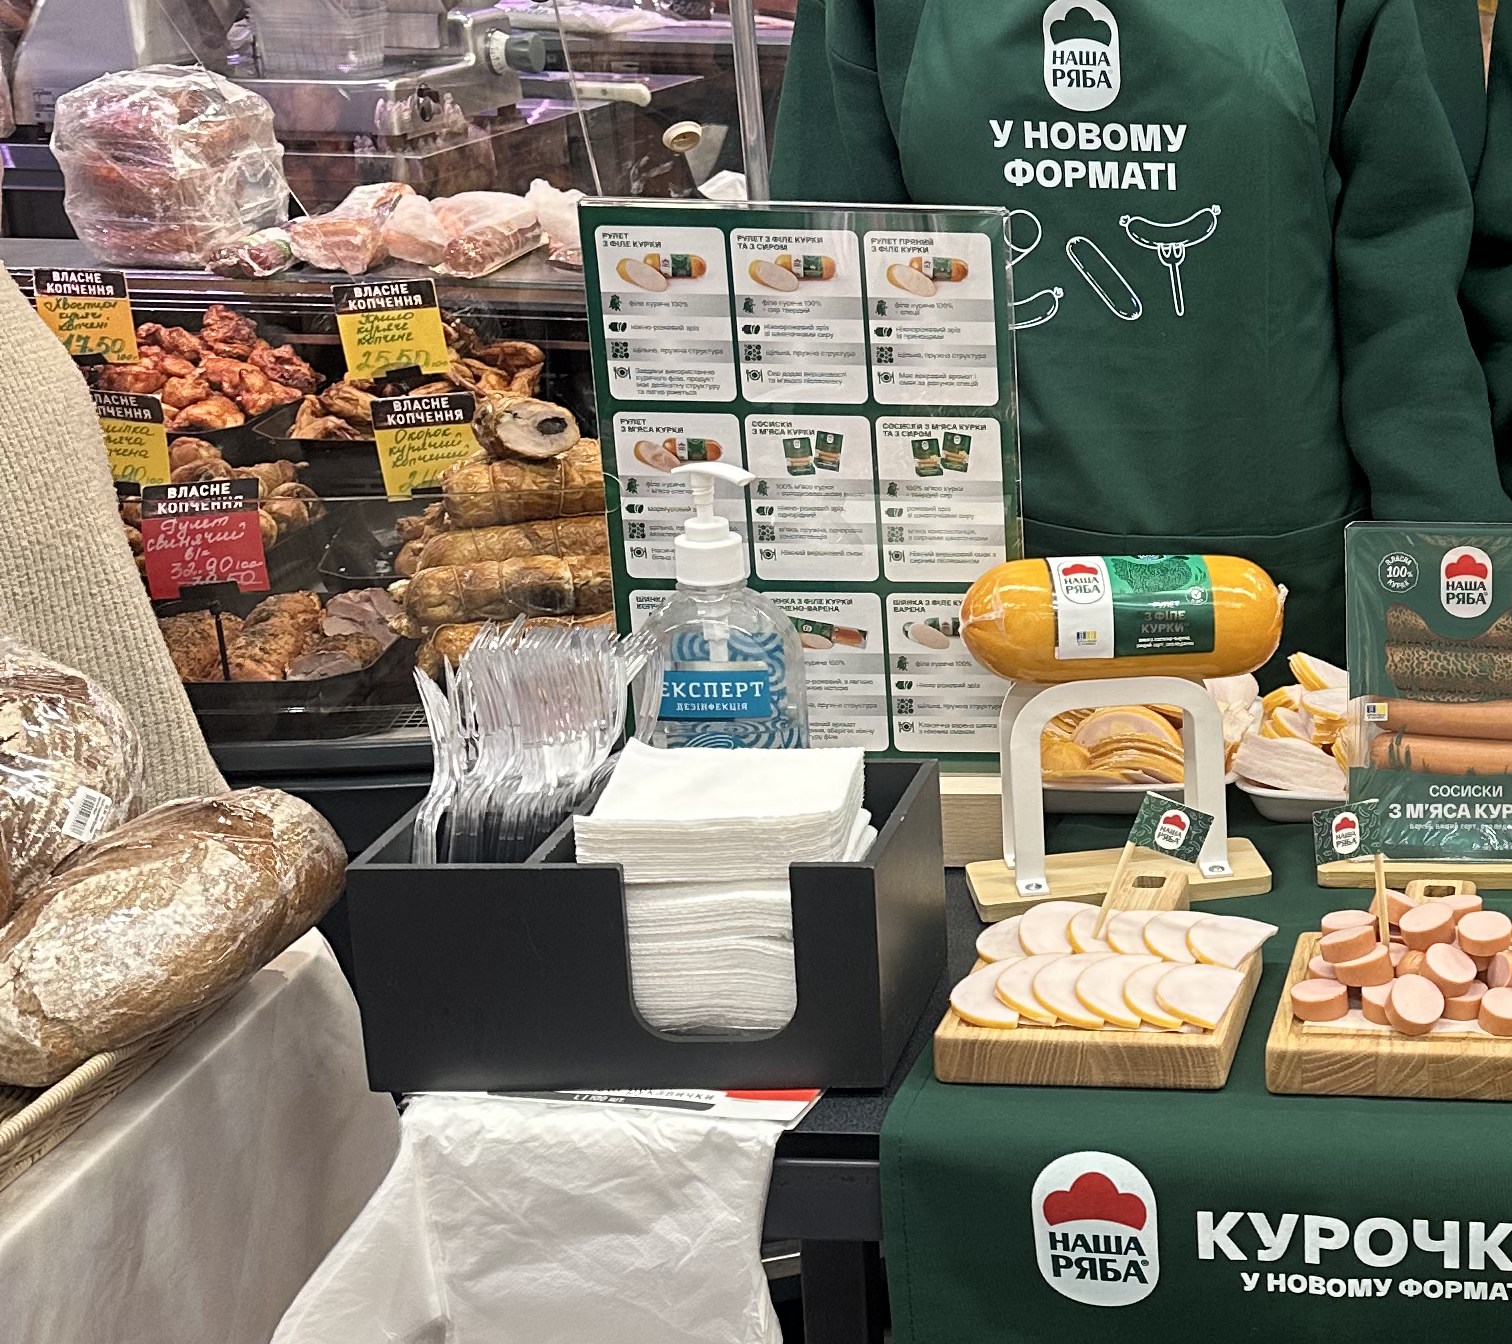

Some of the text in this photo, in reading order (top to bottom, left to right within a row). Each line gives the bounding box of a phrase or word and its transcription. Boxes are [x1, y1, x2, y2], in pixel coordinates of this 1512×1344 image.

[1052, 50, 1111, 67] НАША
[1052, 69, 1112, 88] РЯБА
[989, 119, 1187, 152] У НОВОМУ
[1004, 158, 1177, 190] ФОРМАТІ
[52, 272, 102, 283] ВЛАСНЕ
[47, 283, 114, 295] КОПЧЕННЯ
[353, 284, 408, 297] ВЛАСНЕ
[348, 295, 422, 310] КОПЧЕННЯ
[94, 394, 138, 407] ЛАСНЕ
[393, 397, 450, 411] ВЛАСНЕ
[97, 406, 152, 419] ПЧЕННЯ
[387, 409, 463, 425] КОПЧЕННЯ
[168, 483, 231, 499] ВЛАСНЕ
[1387, 566, 1413, 578] 100%
[1064, 576, 1099, 585] НАША
[1446, 581, 1486, 591] НАША
[1066, 585, 1100, 594] РЯБА
[1446, 593, 1486, 604] РЯБА
[1144, 611, 1186, 621] З ФІЛЕ
[663, 681, 764, 698] ЕКСПЕРТ
[676, 703, 748, 711] ДЕЗІНФЕКЦІЯ
[1429, 785, 1503, 797] СОСИСКИ
[1389, 804, 1401, 819] З
[1406, 804, 1471, 819] М'ЯСА
[1049, 1230, 1148, 1258] НАША
[1051, 1254, 1150, 1285] РЯБА
[1240, 1272, 1260, 1292] У
[1267, 1272, 1392, 1299] НОВОМУ
